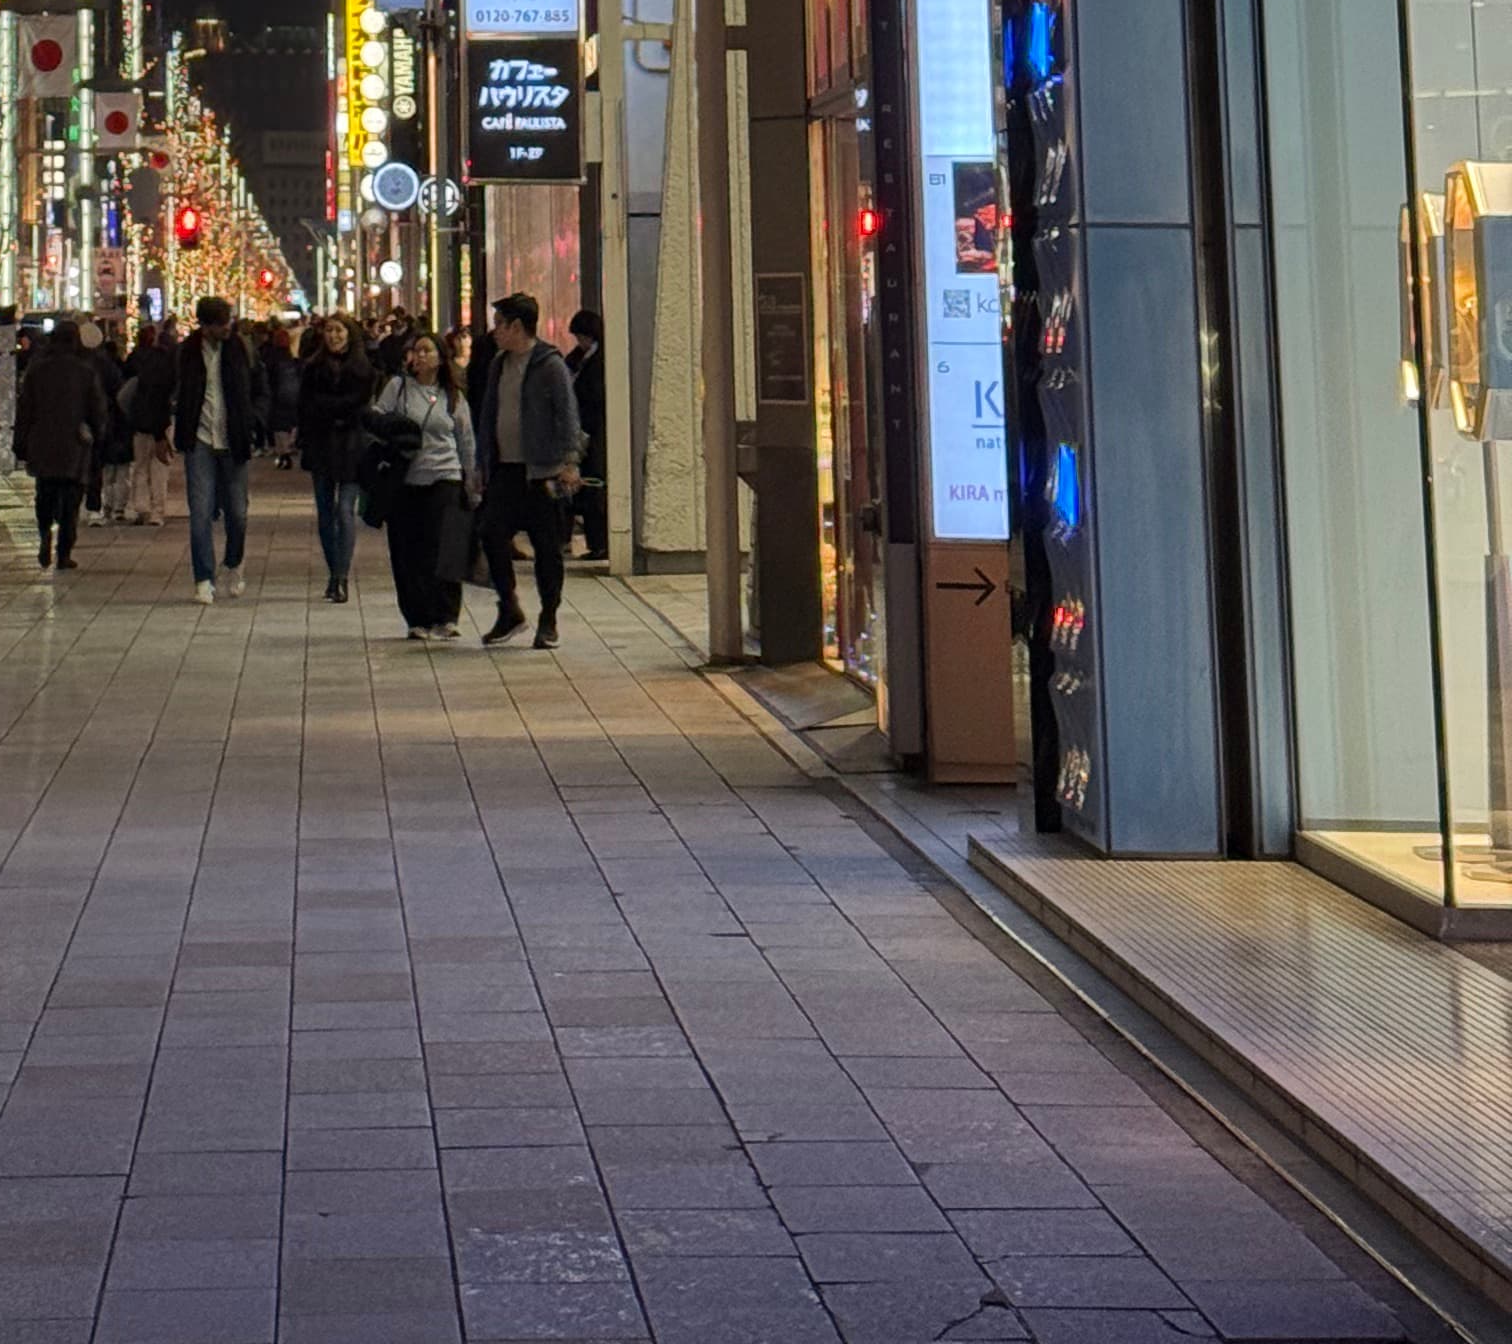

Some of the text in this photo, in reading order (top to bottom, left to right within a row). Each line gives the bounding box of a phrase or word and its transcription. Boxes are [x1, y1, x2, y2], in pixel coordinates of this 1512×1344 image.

[489, 59, 559, 81] カフェー
[948, 483, 989, 502] KIRA
